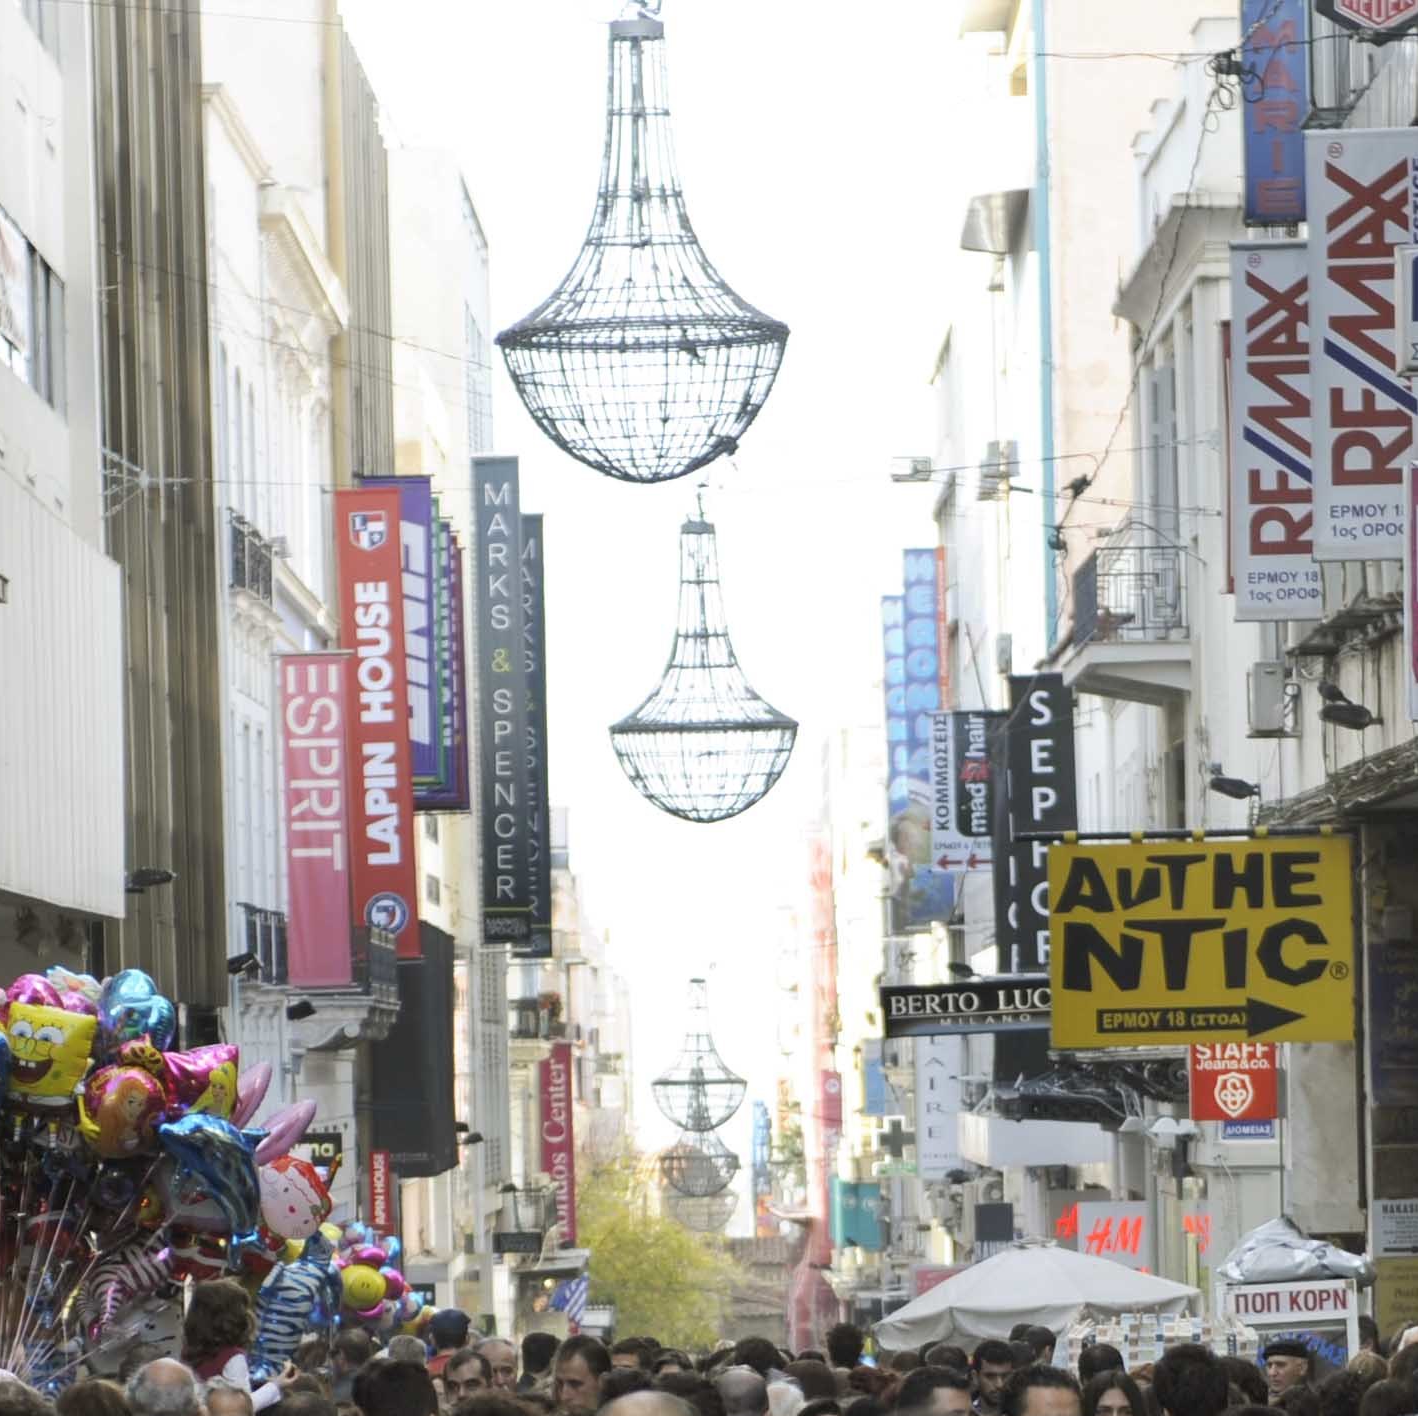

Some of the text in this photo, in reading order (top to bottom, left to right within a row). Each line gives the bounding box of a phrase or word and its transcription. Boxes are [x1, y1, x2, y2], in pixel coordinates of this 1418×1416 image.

[1253, 18, 1300, 215] MARIE
[1329, 503, 1387, 518] ΕΡΜΟΥ
[483, 482, 512, 630] MARKS
[1247, 571, 1319, 585] ΕΡΜΟΥ 18
[491, 647, 513, 673] &
[353, 580, 401, 866] LAPIN HOUSE
[964, 712, 986, 758] hair
[284, 663, 346, 871] ESPRIT
[492, 688, 520, 899] SPENCER
[933, 713, 950, 831] ΚΟΜΜΩΣΕΙΣ
[965, 782, 987, 833] mad
[1063, 917, 1330, 993] NTIC
[890, 991, 980, 1016] BERTO
[1102, 1012, 1160, 1030] ΕΡΜΟΥ
[1165, 1011, 1187, 1029] 18
[542, 1058, 566, 1144] Center
[1234, 1288, 1349, 1315] ΠΟΠ ΚΟΡΝ
